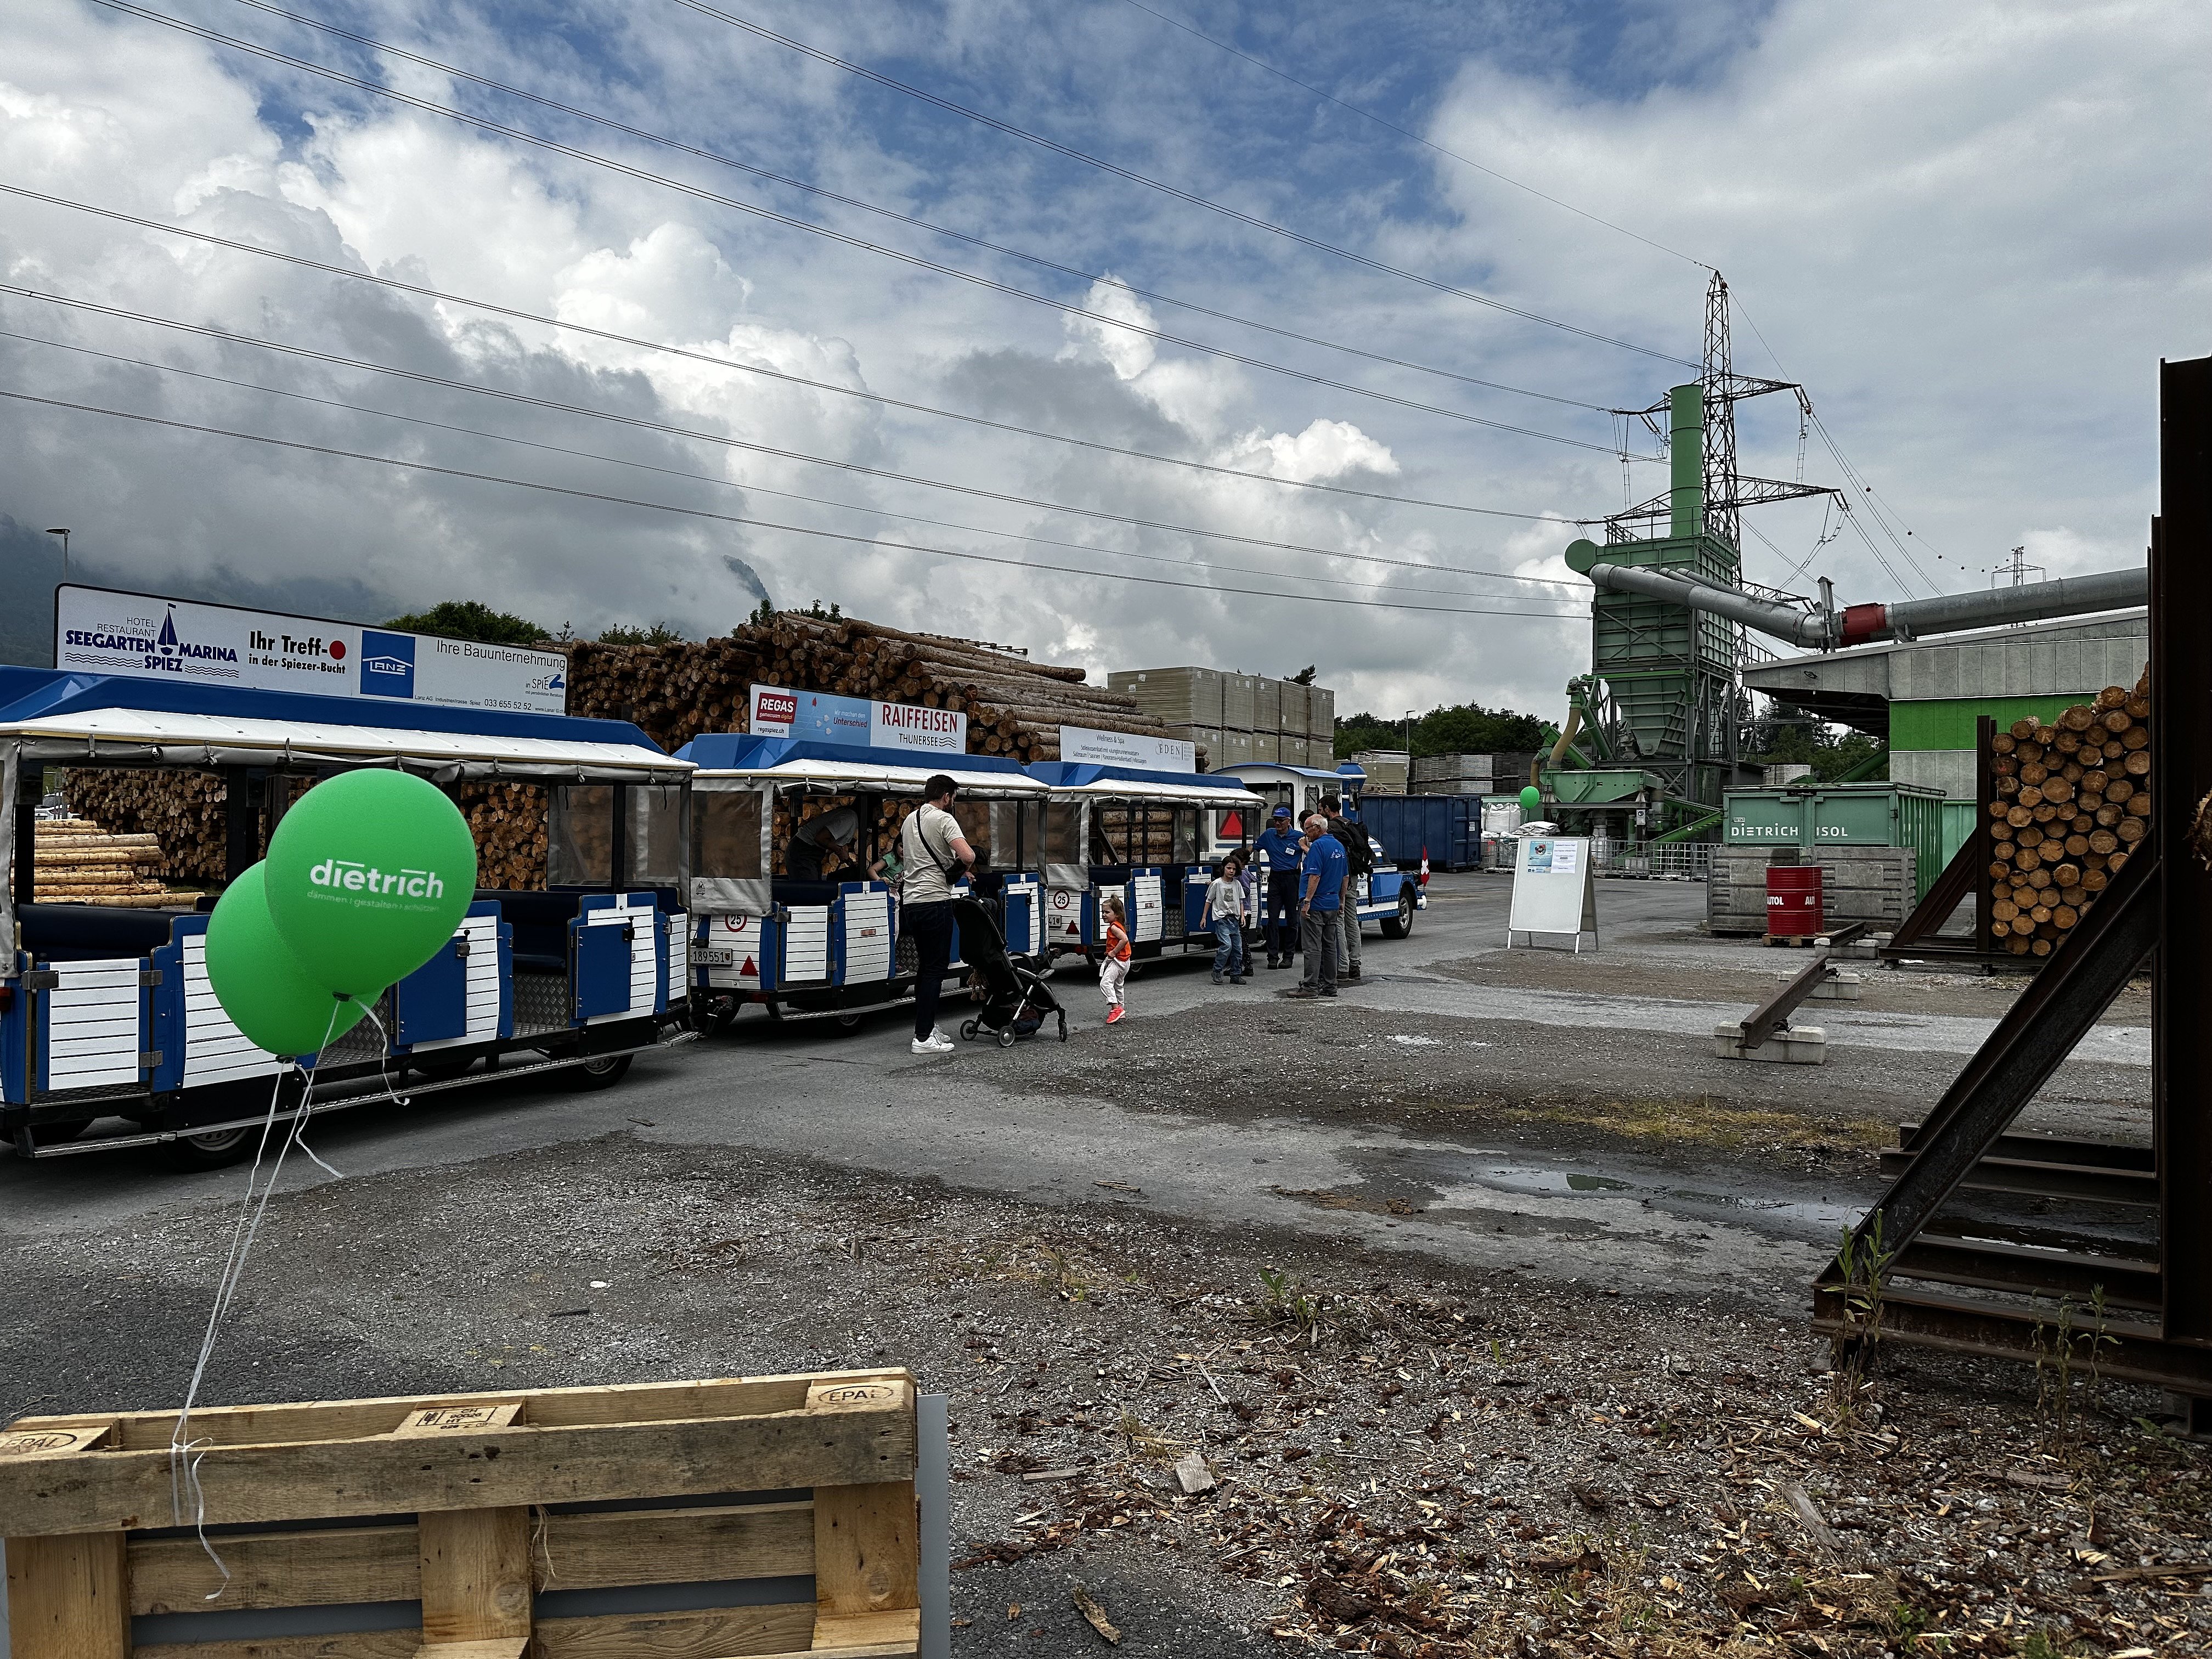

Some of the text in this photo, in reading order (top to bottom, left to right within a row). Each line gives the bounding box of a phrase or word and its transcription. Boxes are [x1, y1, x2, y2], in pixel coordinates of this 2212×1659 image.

[127, 616, 156, 628] HOTEL
[97, 623, 156, 637] RESTAURANT
[66, 630, 238, 662] SEEGARTEN MARINA
[250, 630, 275, 651] Ihr
[437, 640, 566, 671] Ihre Bauunternehmung
[144, 655, 183, 672] SPIEZ
[249, 653, 346, 674] in der Spiezer-Bucht
[370, 661, 405, 675] LANZ
[499, 700, 511, 708] 655
[760, 698, 794, 713] REGAS
[833, 716, 868, 728] Unterschied
[882, 704, 958, 733] RAIFFEISEN
[899, 733, 938, 746] THUNERSEE
[1096, 734, 1113, 743] Wellness
[1159, 743, 1180, 755] EDEN
[1816, 826, 1848, 837] ISOL
[310, 859, 444, 898] dietrich
[307, 889, 348, 904] dämmen
[354, 899, 400, 909] gestalten
[1058, 896, 1066, 904] 25
[730, 914, 742, 925] 25
[693, 951, 725, 962] 189551
